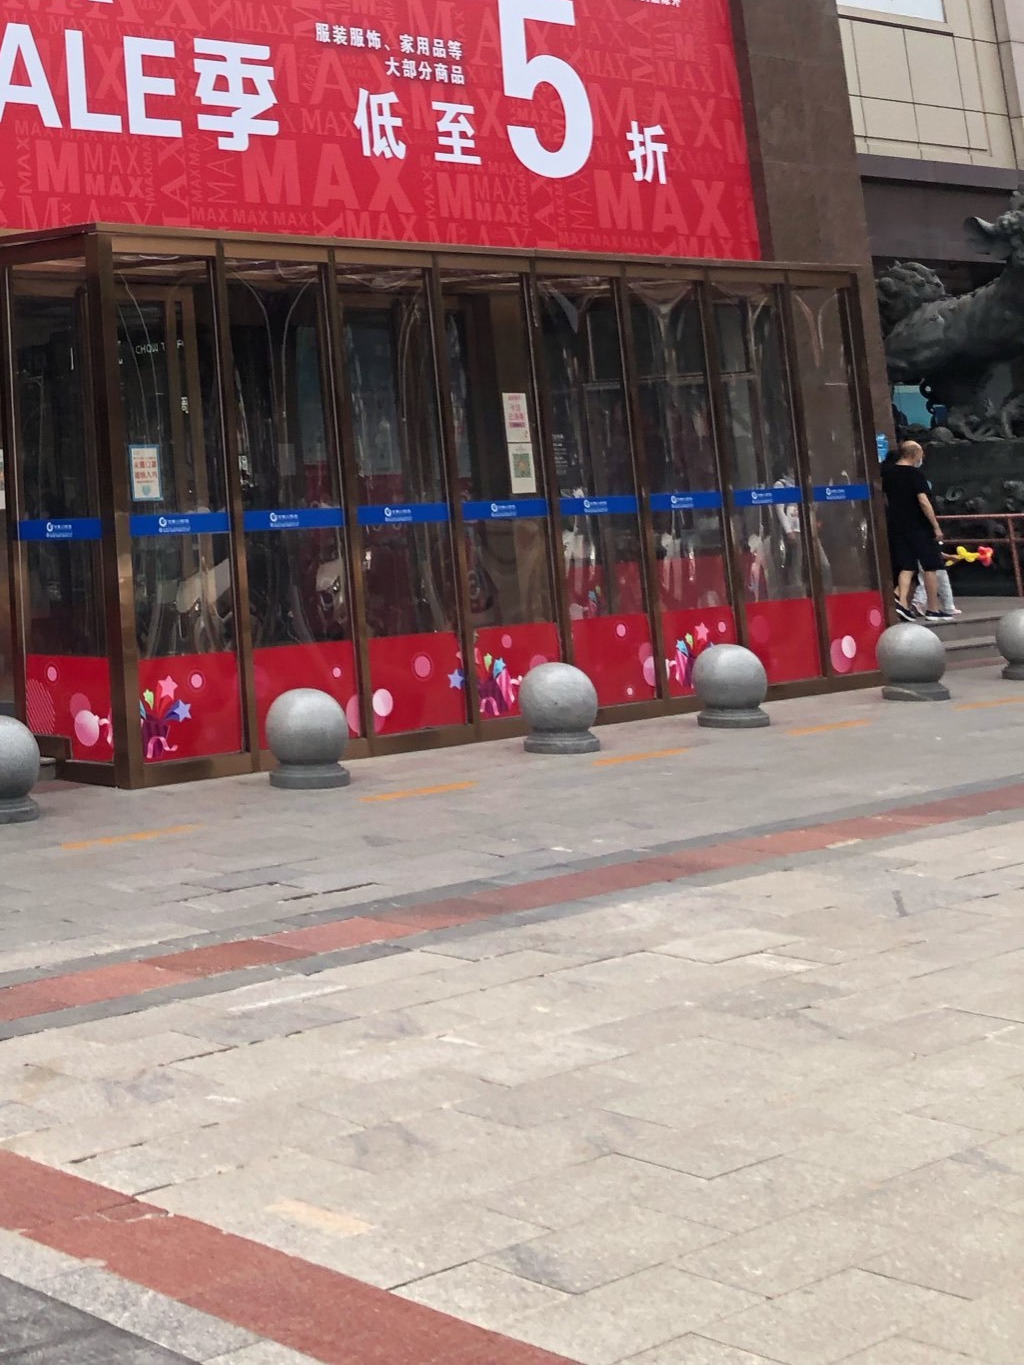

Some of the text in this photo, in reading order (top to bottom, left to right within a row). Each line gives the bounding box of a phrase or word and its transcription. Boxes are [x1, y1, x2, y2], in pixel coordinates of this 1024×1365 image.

[234, 0, 289, 35] MAX
[385, 57, 465, 85] 大部分商品
[83, 142, 141, 175] MAX
[242, 137, 414, 214] MAX
[85, 173, 145, 198] MAX
[593, 169, 732, 238] MAX
